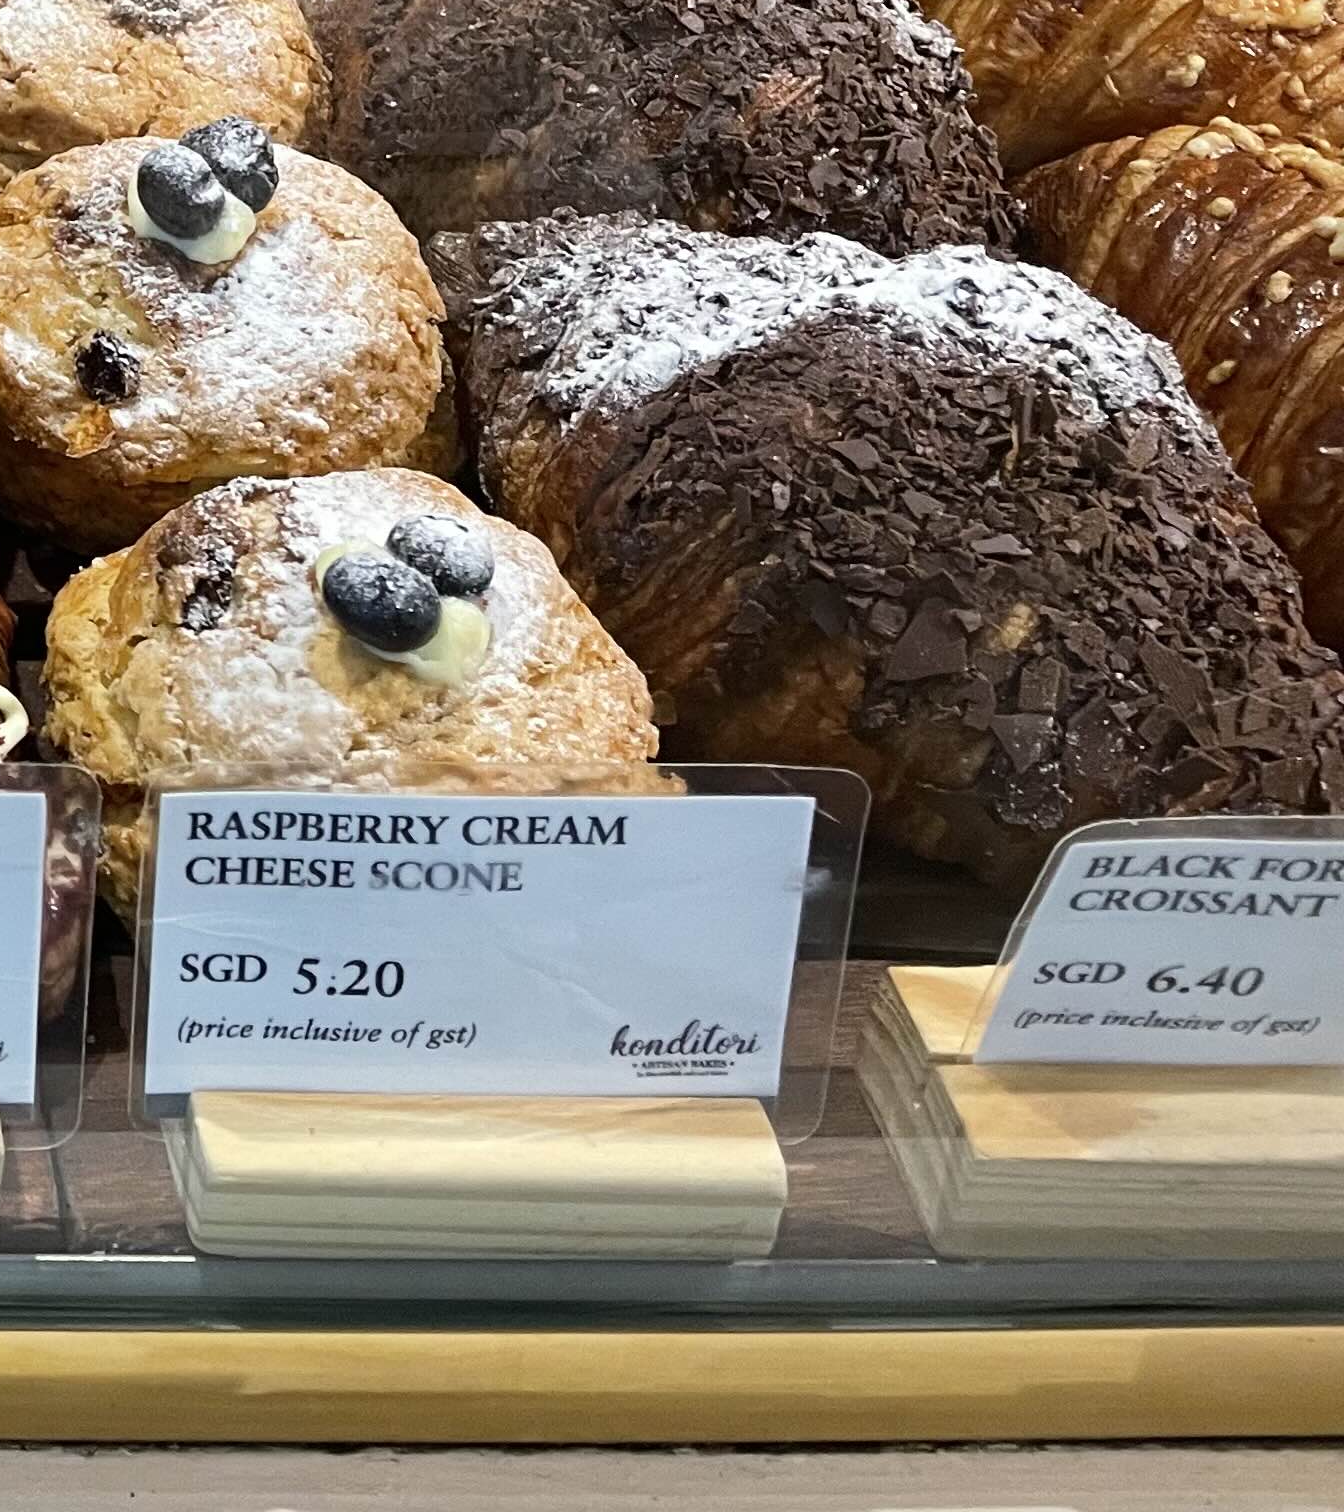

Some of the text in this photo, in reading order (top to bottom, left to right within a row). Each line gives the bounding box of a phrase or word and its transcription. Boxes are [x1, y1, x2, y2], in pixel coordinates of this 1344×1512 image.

[187, 810, 628, 846] RASPBERRY CREAM
[184, 855, 524, 892] CHEESE SCONE
[1082, 854, 1246, 880] BLACK
[1069, 888, 1339, 918] CROISSANT
[179, 952, 406, 998] SGD 5.20
[1032, 961, 1266, 997] SGD 6.40
[176, 1016, 478, 1051] (price inclusive of gst)
[609, 1018, 762, 1057] konditori
[1012, 1007, 1322, 1037] (price inclusive of gst)
